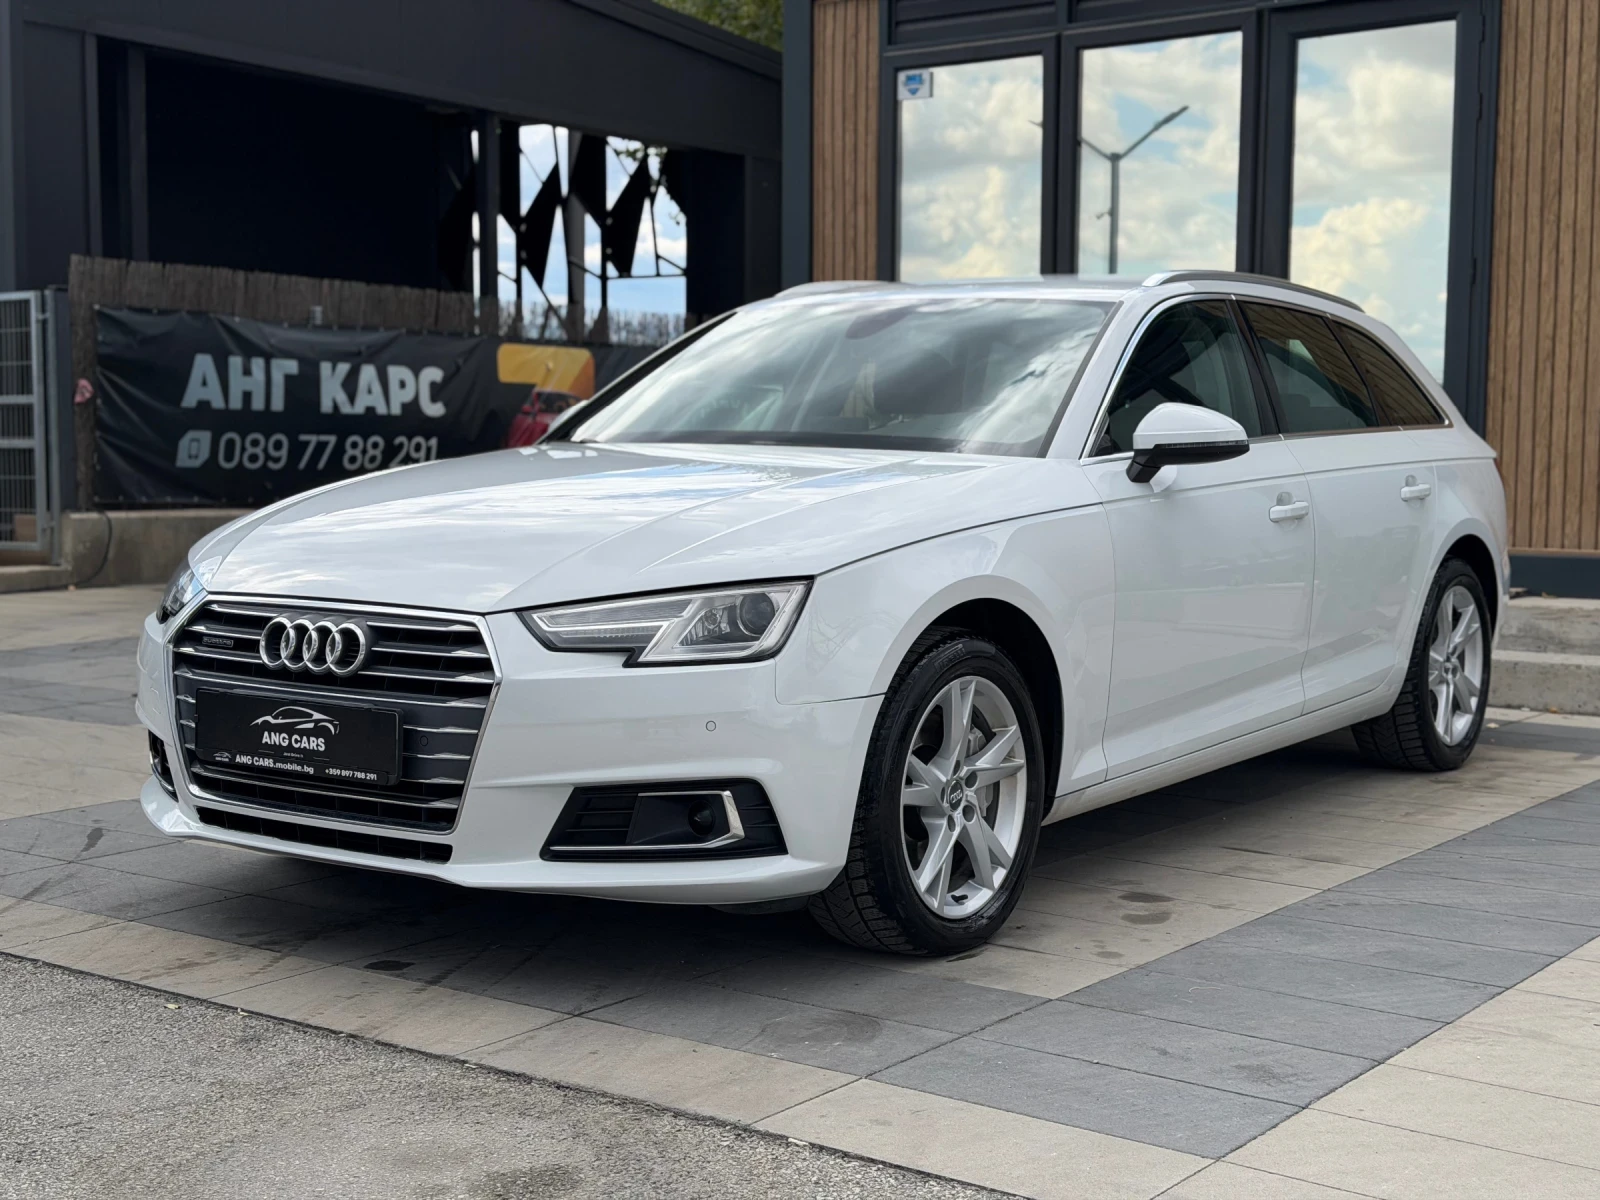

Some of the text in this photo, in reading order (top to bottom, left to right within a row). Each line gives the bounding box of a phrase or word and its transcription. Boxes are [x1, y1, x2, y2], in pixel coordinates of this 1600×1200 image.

[180, 352, 447, 418] АНГ КАРС
[217, 431, 439, 471] 089 77 88 291
[261, 730, 326, 751] ANG CARS
[235, 754, 252, 765] ANG
[253, 756, 314, 774] CARS.mobile.bg
[325, 768, 378, 781] +359 897 788 291
